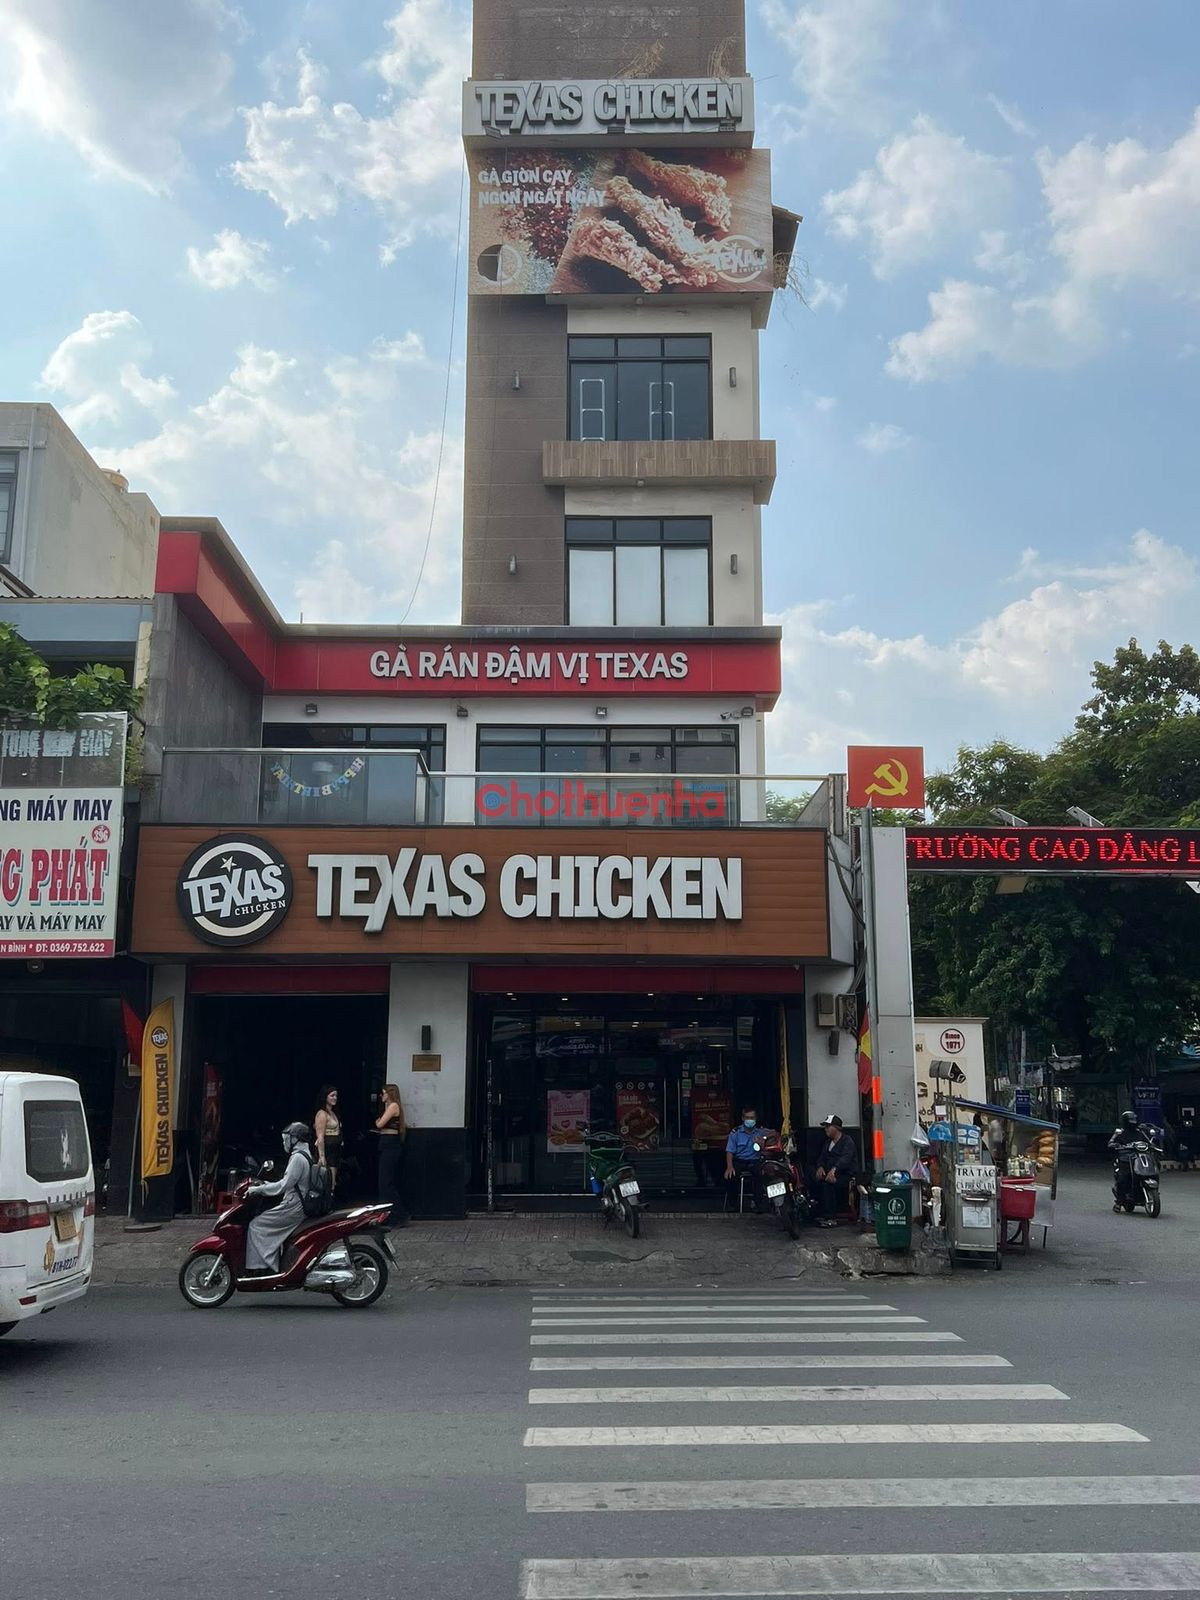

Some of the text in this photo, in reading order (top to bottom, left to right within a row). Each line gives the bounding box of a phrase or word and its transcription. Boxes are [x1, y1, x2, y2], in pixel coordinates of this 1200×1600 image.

[476, 82, 743, 132] TEXAS CHICKEN
[478, 166, 572, 187] GÀ GIÒN CAY
[370, 644, 688, 684] GÀ RÁN ĐẬM VỊ TEXAS
[27, 795, 67, 821] MÁY
[73, 800, 112, 821] MAY
[1029, 837, 1090, 861] CAO
[0, 836, 109, 904] G PHÁT
[183, 865, 285, 918] TEXAS
[308, 848, 742, 932] TEXAS CHICKEN
[235, 900, 286, 916] CHICKEN
[17, 912, 36, 931] VÀ
[40, 911, 72, 931] MÁY
[75, 915, 105, 931] MAY
[8, 942, 26, 953] BÌNH
[36, 943, 48, 953] ĐT:
[50, 943, 105, 953] 0369.752.622
[152, 1032, 168, 1043] TEXAS
[155, 1054, 169, 1167] TEXAS CHICKEN
[957, 1166, 974, 1177] TRÀ
